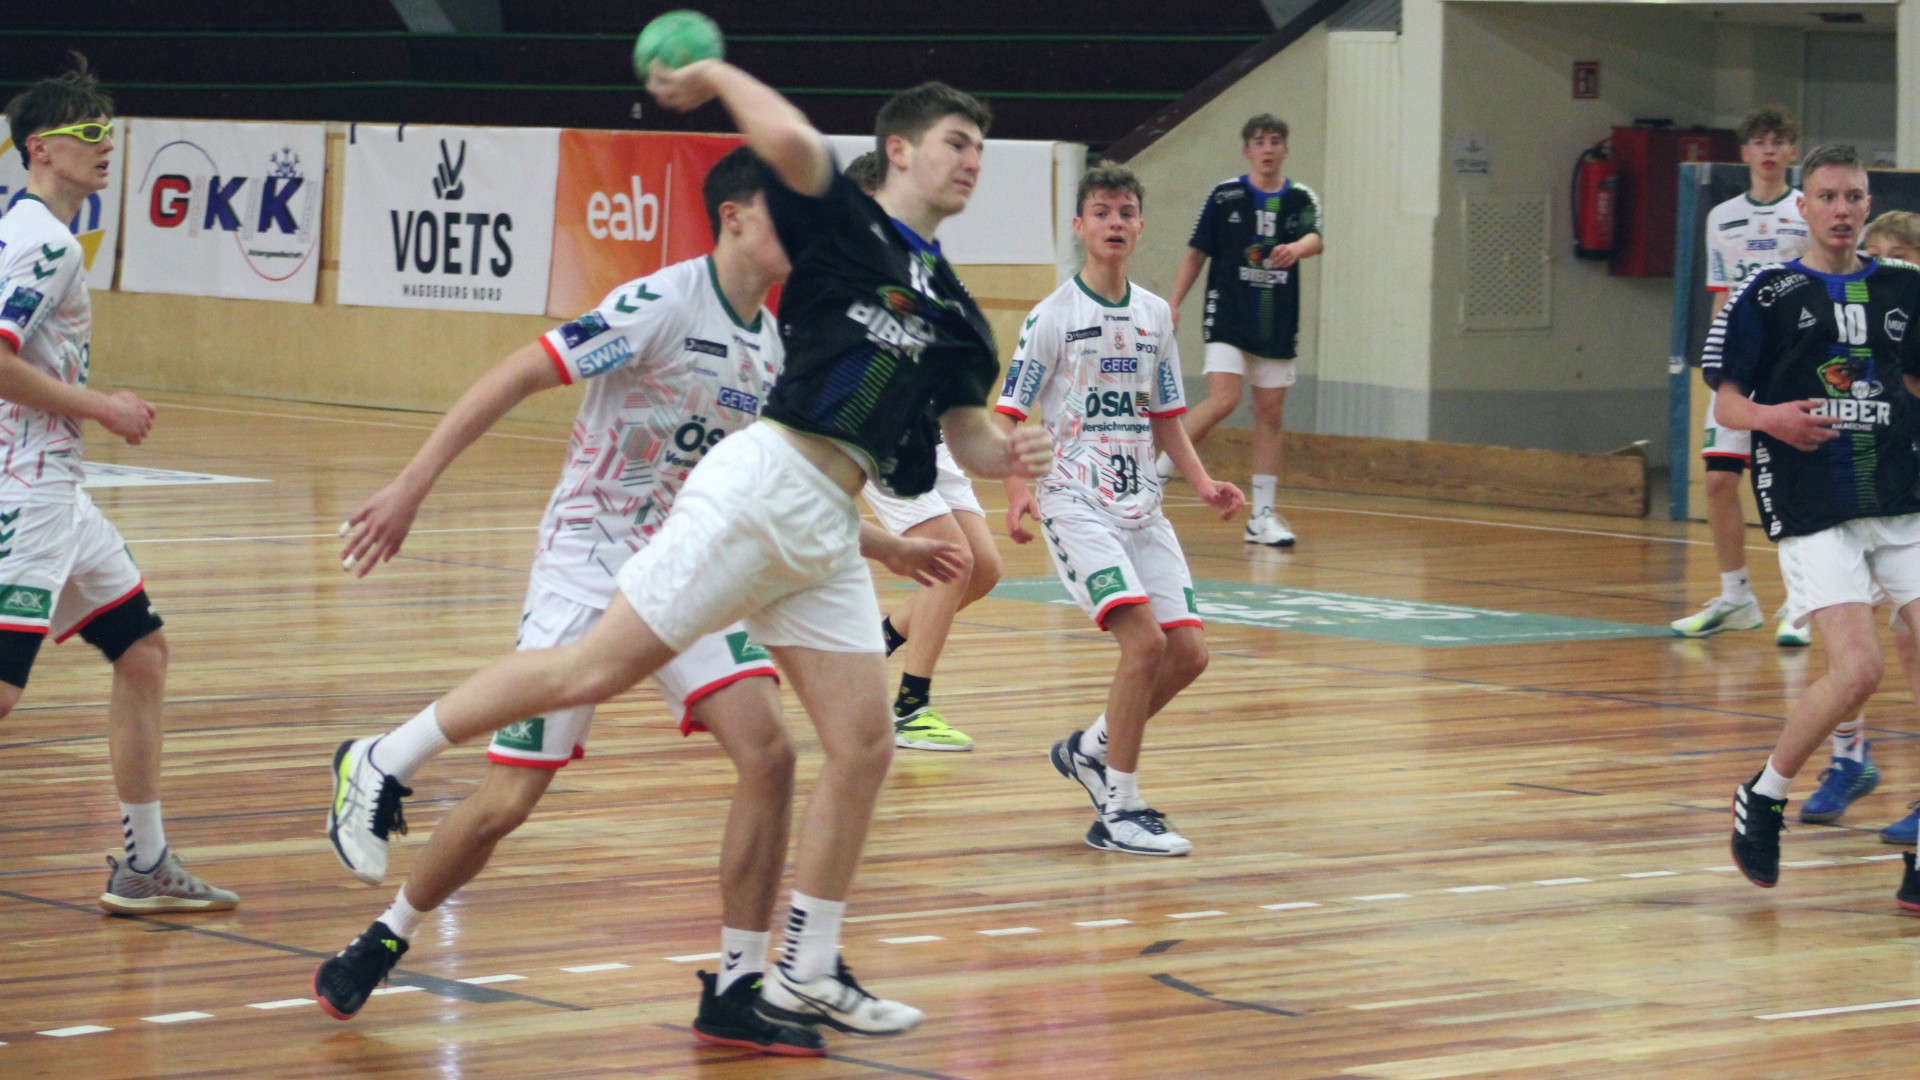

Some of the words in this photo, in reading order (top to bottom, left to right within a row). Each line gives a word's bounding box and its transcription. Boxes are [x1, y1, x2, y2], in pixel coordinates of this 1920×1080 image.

[148, 173, 304, 235] GKK
[586, 174, 659, 242] eab
[1255, 209, 1278, 237] 15
[390, 209, 514, 278] VOETS
[403, 284, 468, 299] MAGDEBURG
[472, 287, 502, 301] NORD
[1239, 266, 1289, 284] BIBER
[1833, 301, 1868, 346] 10
[578, 338, 630, 375] SWM
[1020, 360, 1041, 404] SWM
[1085, 386, 1135, 418] ÖSA
[5, 590, 44, 609] AOK
